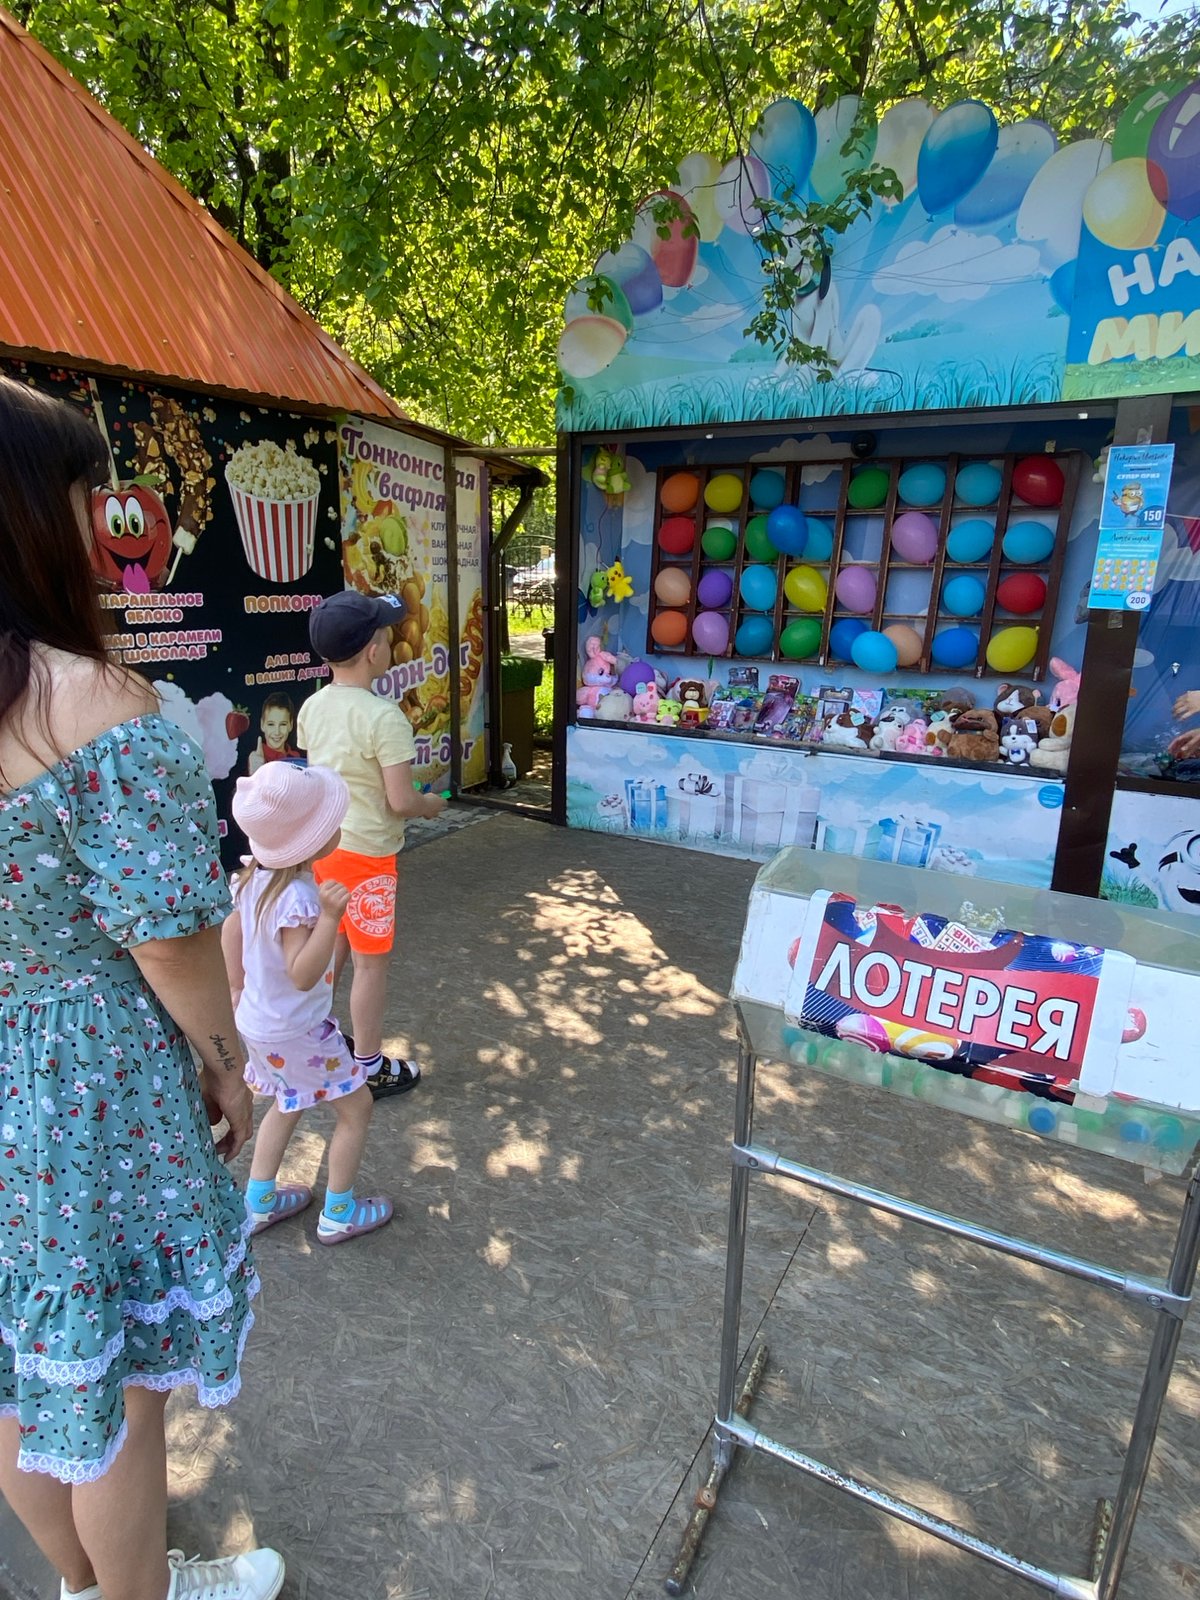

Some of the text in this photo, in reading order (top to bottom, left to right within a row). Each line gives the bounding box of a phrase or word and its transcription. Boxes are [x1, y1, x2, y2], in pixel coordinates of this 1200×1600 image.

[379, 472, 447, 512] вафля
[1143, 510, 1162, 521] 150
[431, 521, 477, 535] КЛУЧНАЯ
[431, 539, 473, 551] ВАННАЯ
[432, 556, 479, 568] ШОКАДНАЯ
[432, 574, 461, 582] СЫТЯ
[244, 595, 323, 613] ПОПКОРН
[125, 609, 183, 624] ЯБЛОКО
[103, 629, 222, 650] НАН В КАРАМЕЛИ
[123, 644, 207, 664] ШОКОЛАДЕ
[265, 652, 311, 669] ДЛЯ ВАС
[245, 663, 330, 686] И ВАШИХ ДЕТЕЙ
[376, 644, 470, 700] орн-дг
[953, 929, 981, 951] BING
[814, 942, 1080, 1061] ЛОТЕРЕЯ
